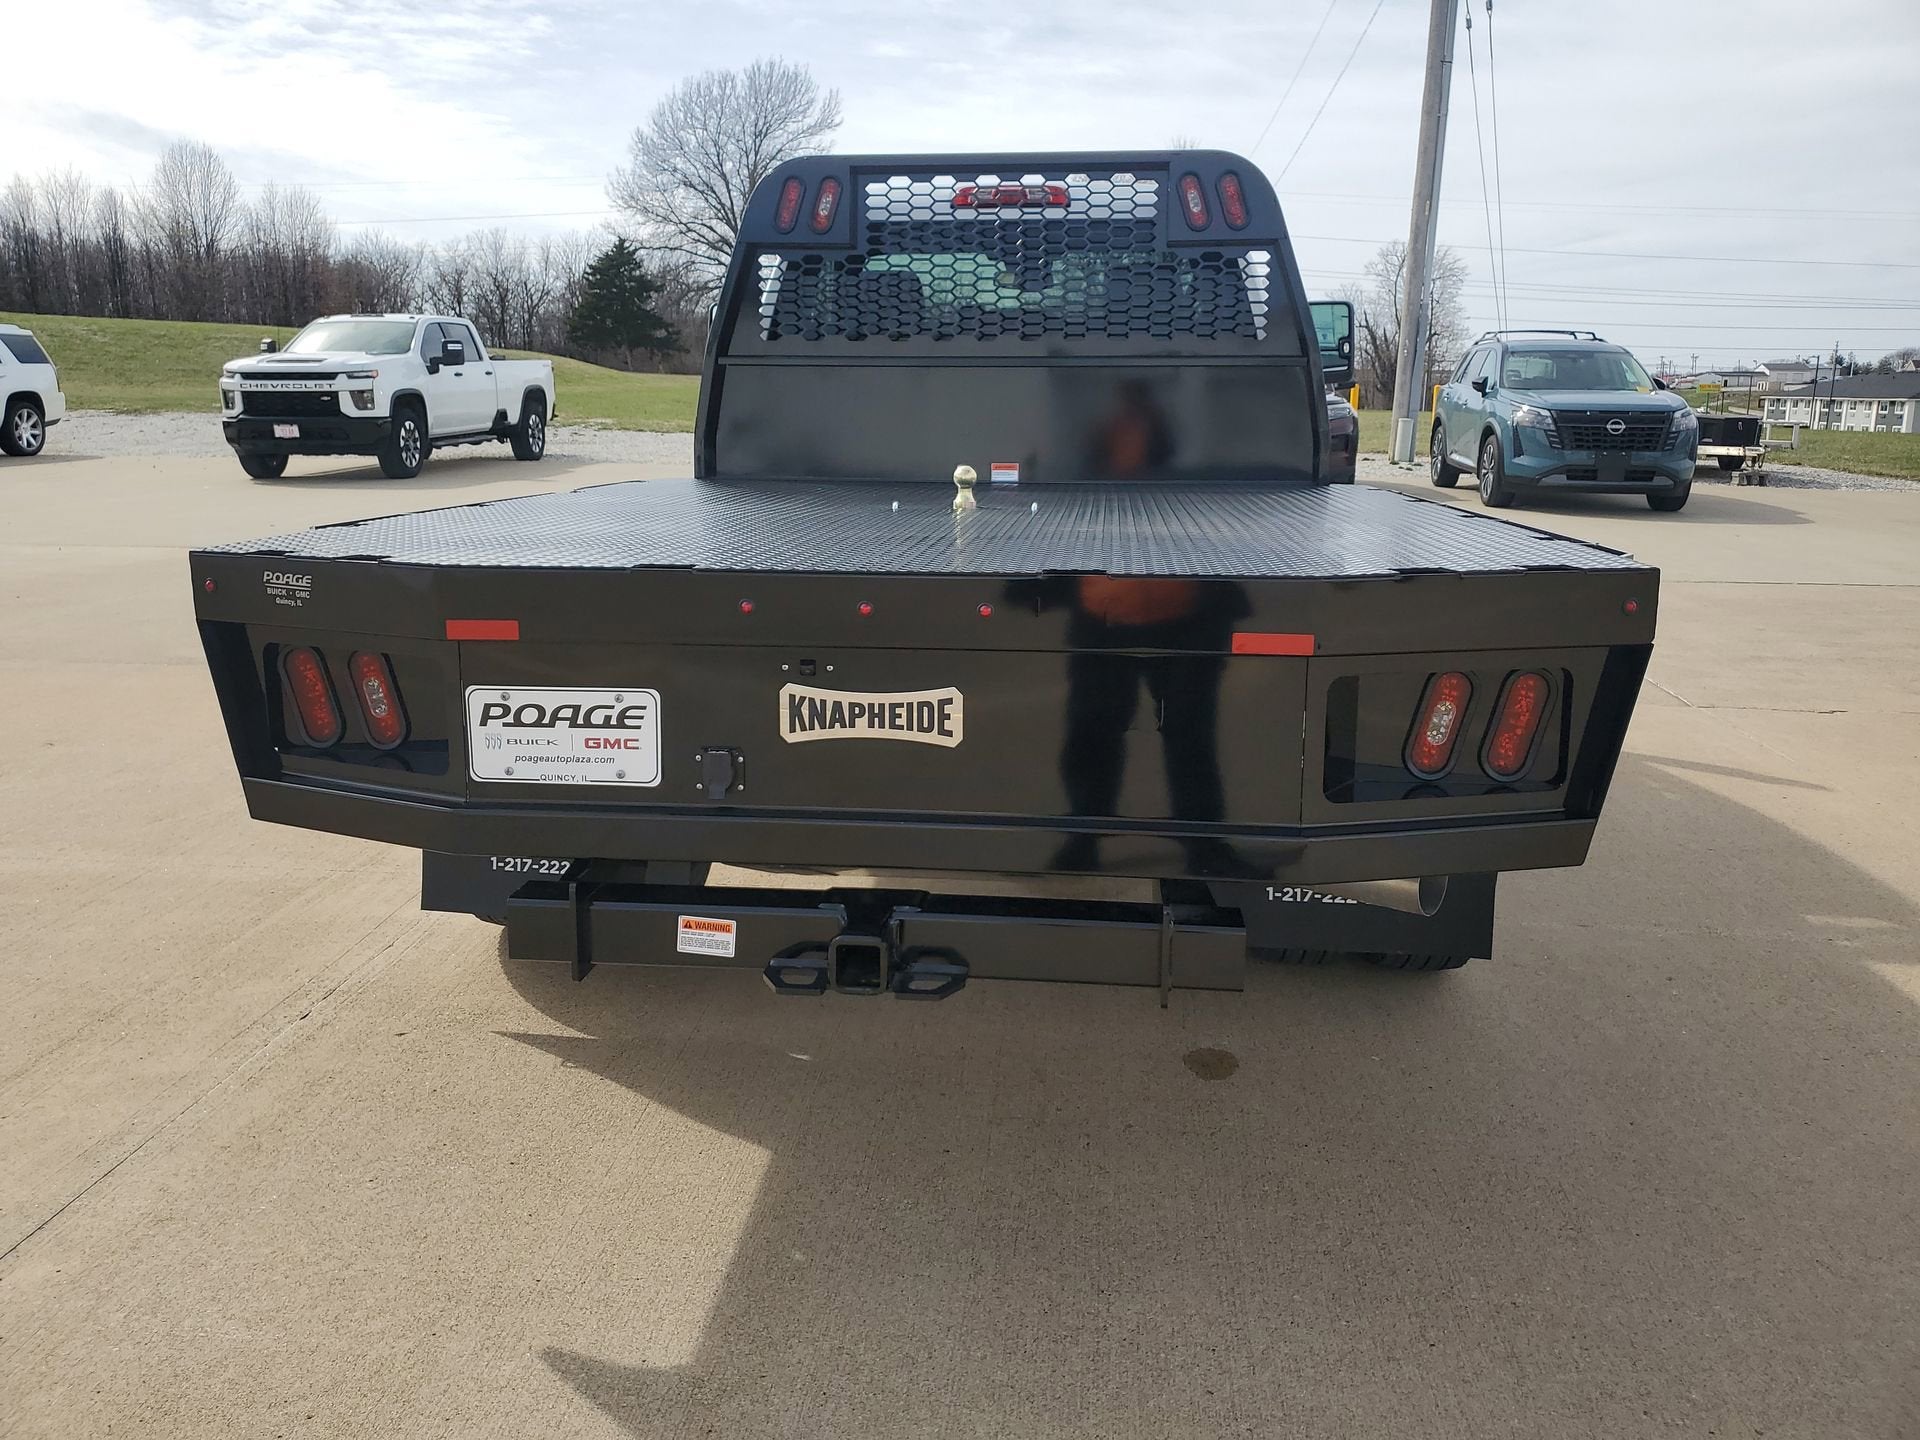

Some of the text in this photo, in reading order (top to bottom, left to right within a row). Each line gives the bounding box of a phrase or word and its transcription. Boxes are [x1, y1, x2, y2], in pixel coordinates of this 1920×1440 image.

[263, 571, 312, 586] POAGE
[266, 587, 310, 599] BUICK GMC
[479, 702, 647, 729] POAGE
[788, 693, 954, 738] KNAPHEIDE
[506, 737, 641, 750] BUICK GMC
[514, 754, 616, 764] poageautoplaza.com
[539, 774, 590, 783] QUINCY, IL
[694, 921, 732, 933] WARNING
